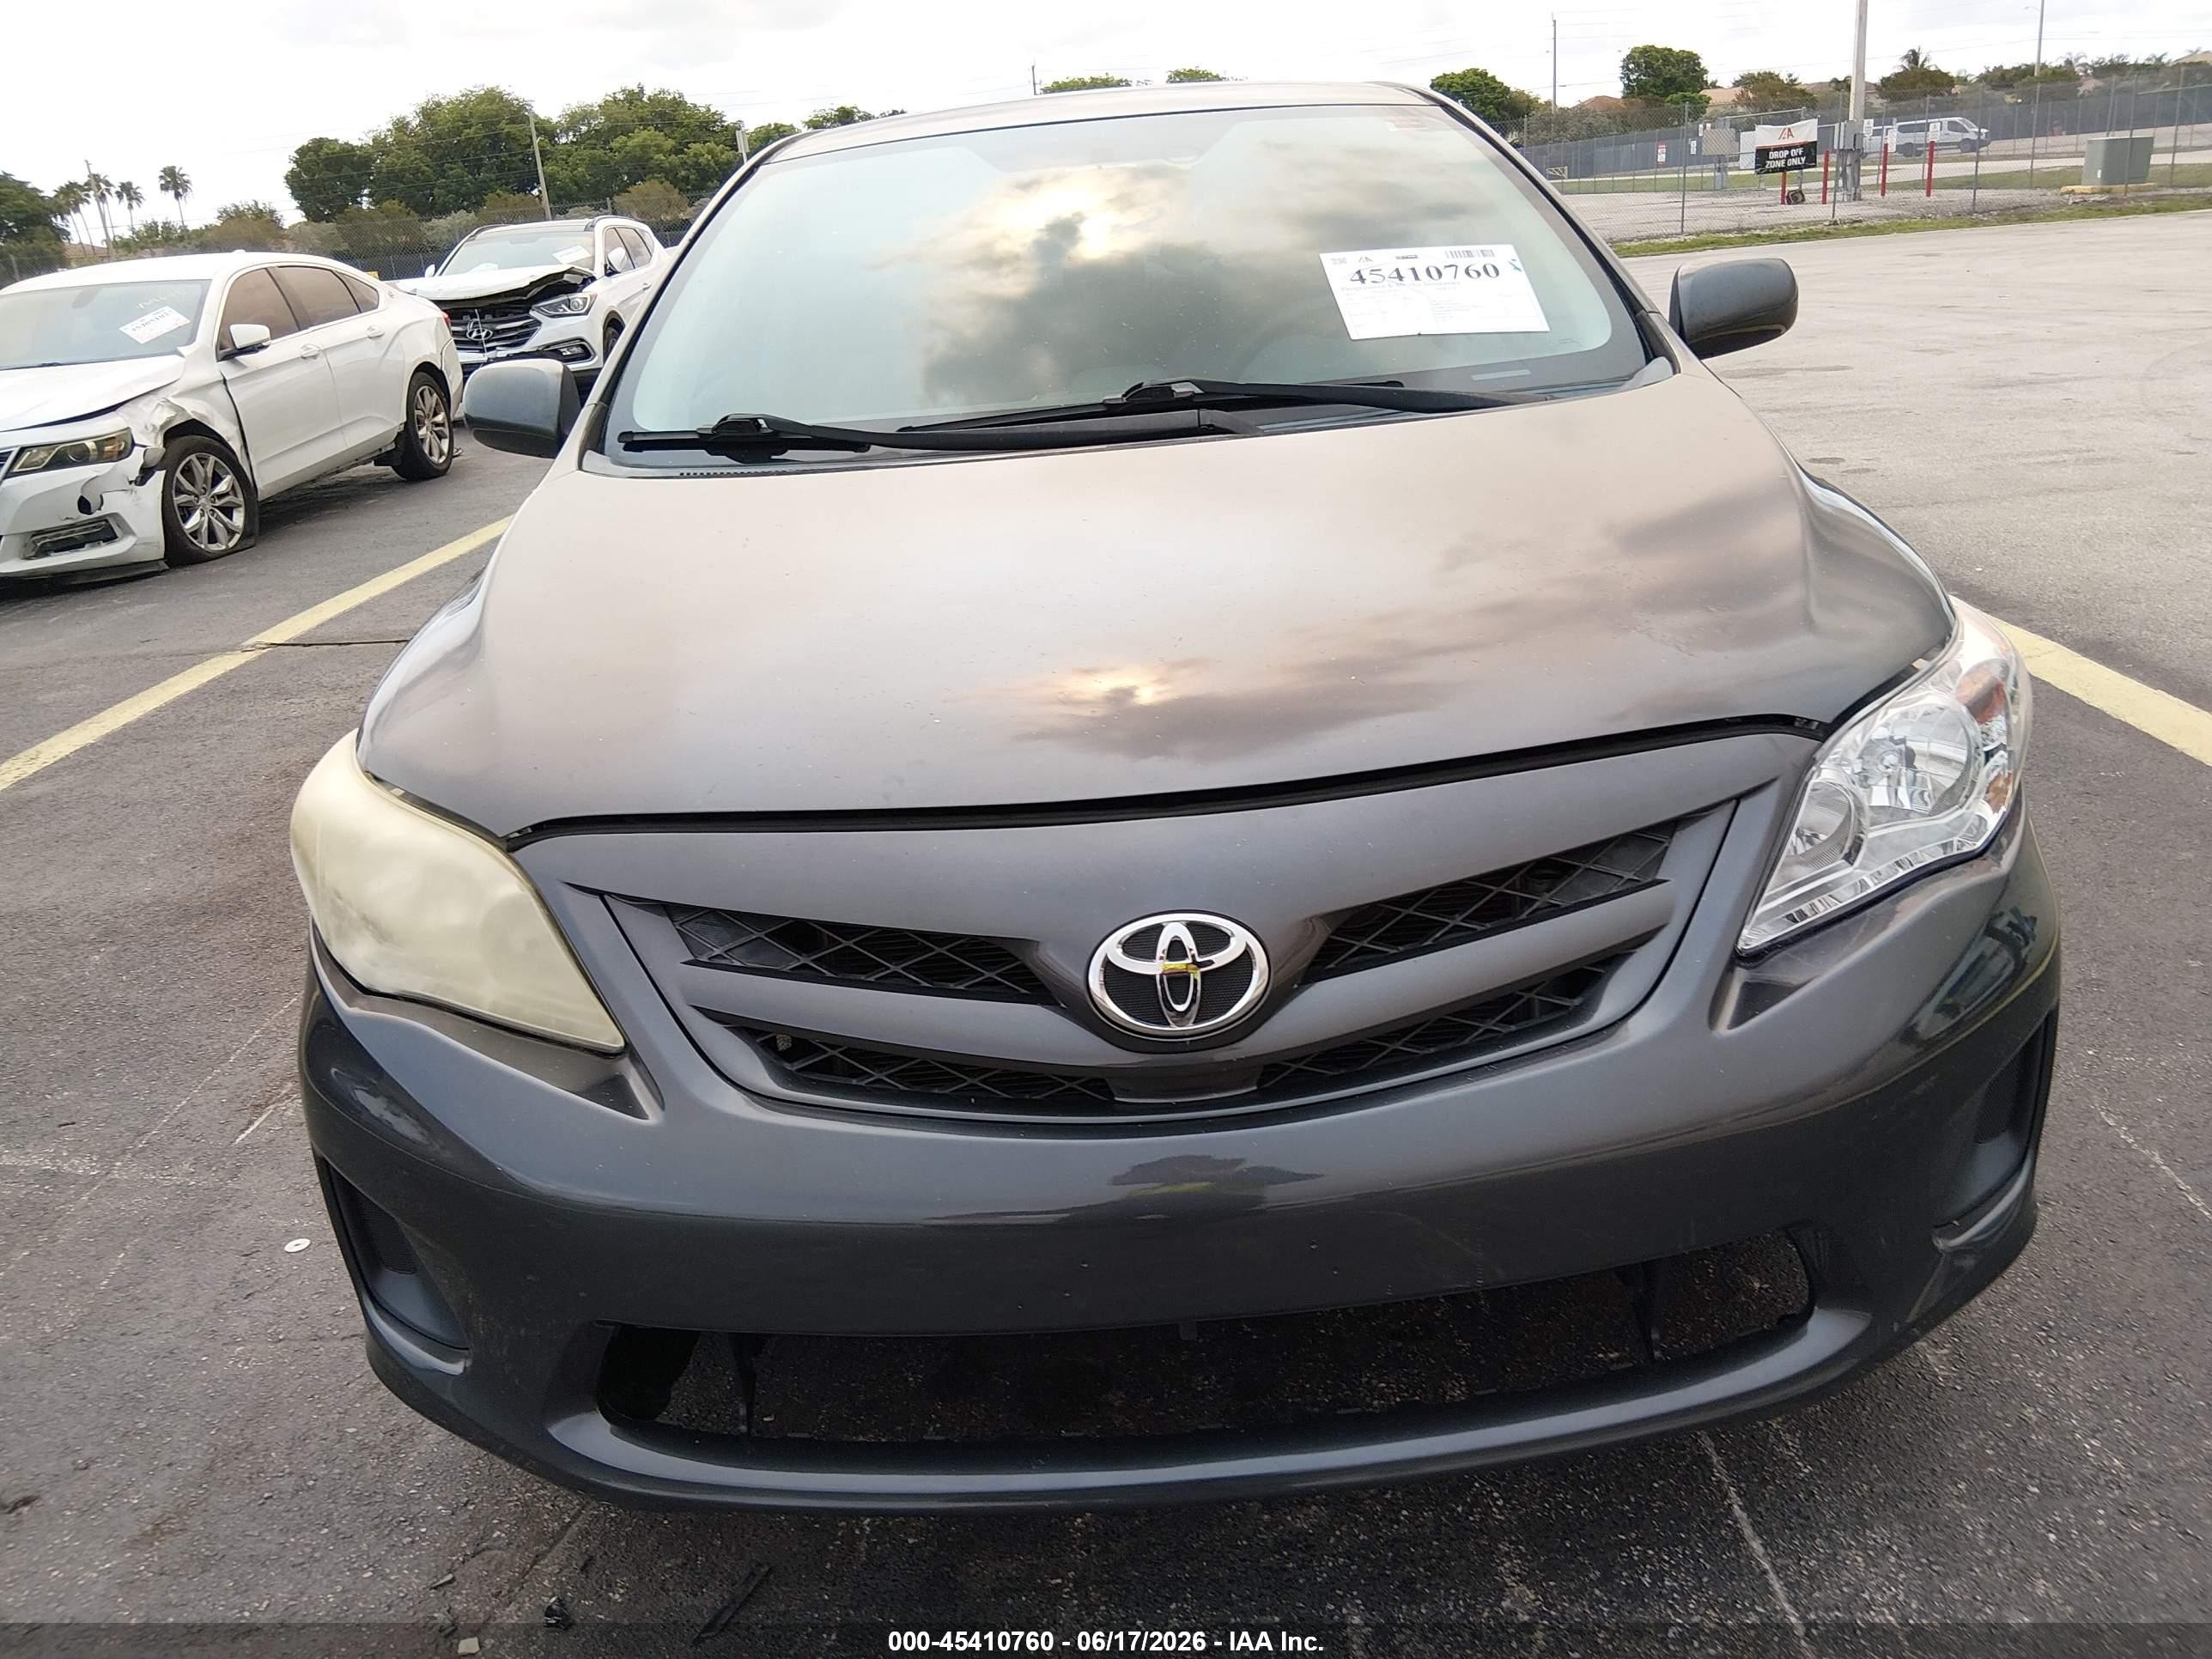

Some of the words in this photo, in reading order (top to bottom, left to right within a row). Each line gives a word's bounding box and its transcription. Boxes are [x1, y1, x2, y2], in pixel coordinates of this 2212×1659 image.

[1769, 149, 1789, 160] DROP
[1790, 148, 1804, 157] OFF
[1765, 160, 1786, 168] ZONE
[1787, 156, 1807, 167] ONLY
[1350, 263, 1500, 284] 45410760
